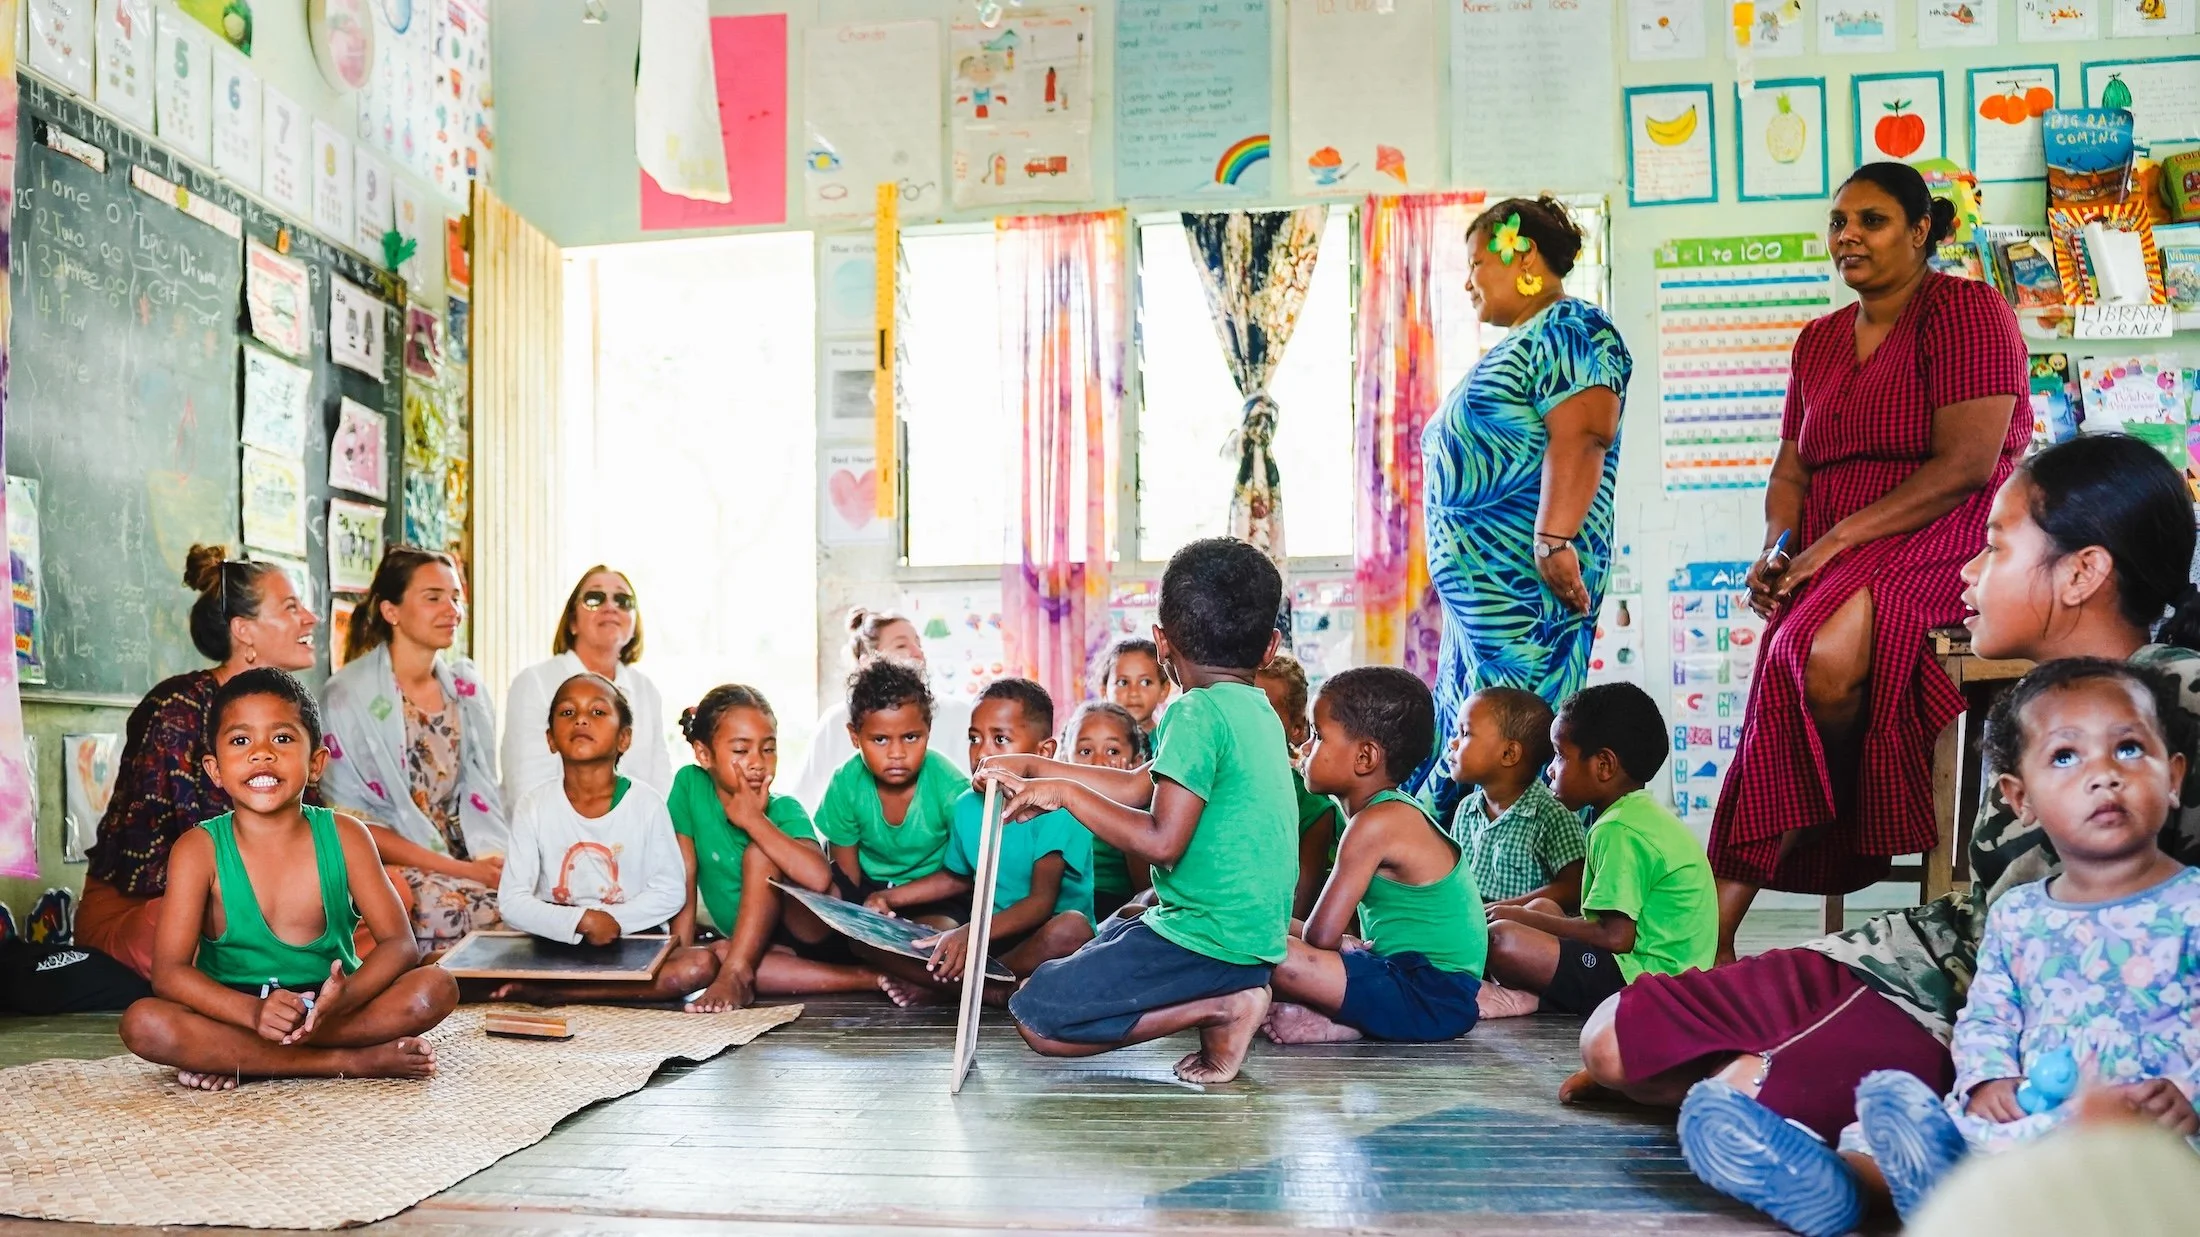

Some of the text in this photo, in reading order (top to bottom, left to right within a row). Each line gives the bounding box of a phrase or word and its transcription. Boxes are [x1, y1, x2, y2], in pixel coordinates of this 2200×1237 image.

[174, 37, 188, 79] 5
[228, 76, 240, 111] 6
[277, 104, 290, 144] 7
[2051, 112, 2127, 130] BIG RAIN
[2056, 131, 2118, 146] COMING
[325, 143, 336, 177] 8
[52, 180, 92, 212] one
[36, 207, 86, 248] 2 Two
[37, 244, 53, 278] 3
[1698, 242, 1783, 263] 1 to 100
[2082, 304, 2167, 323] LIBRARY
